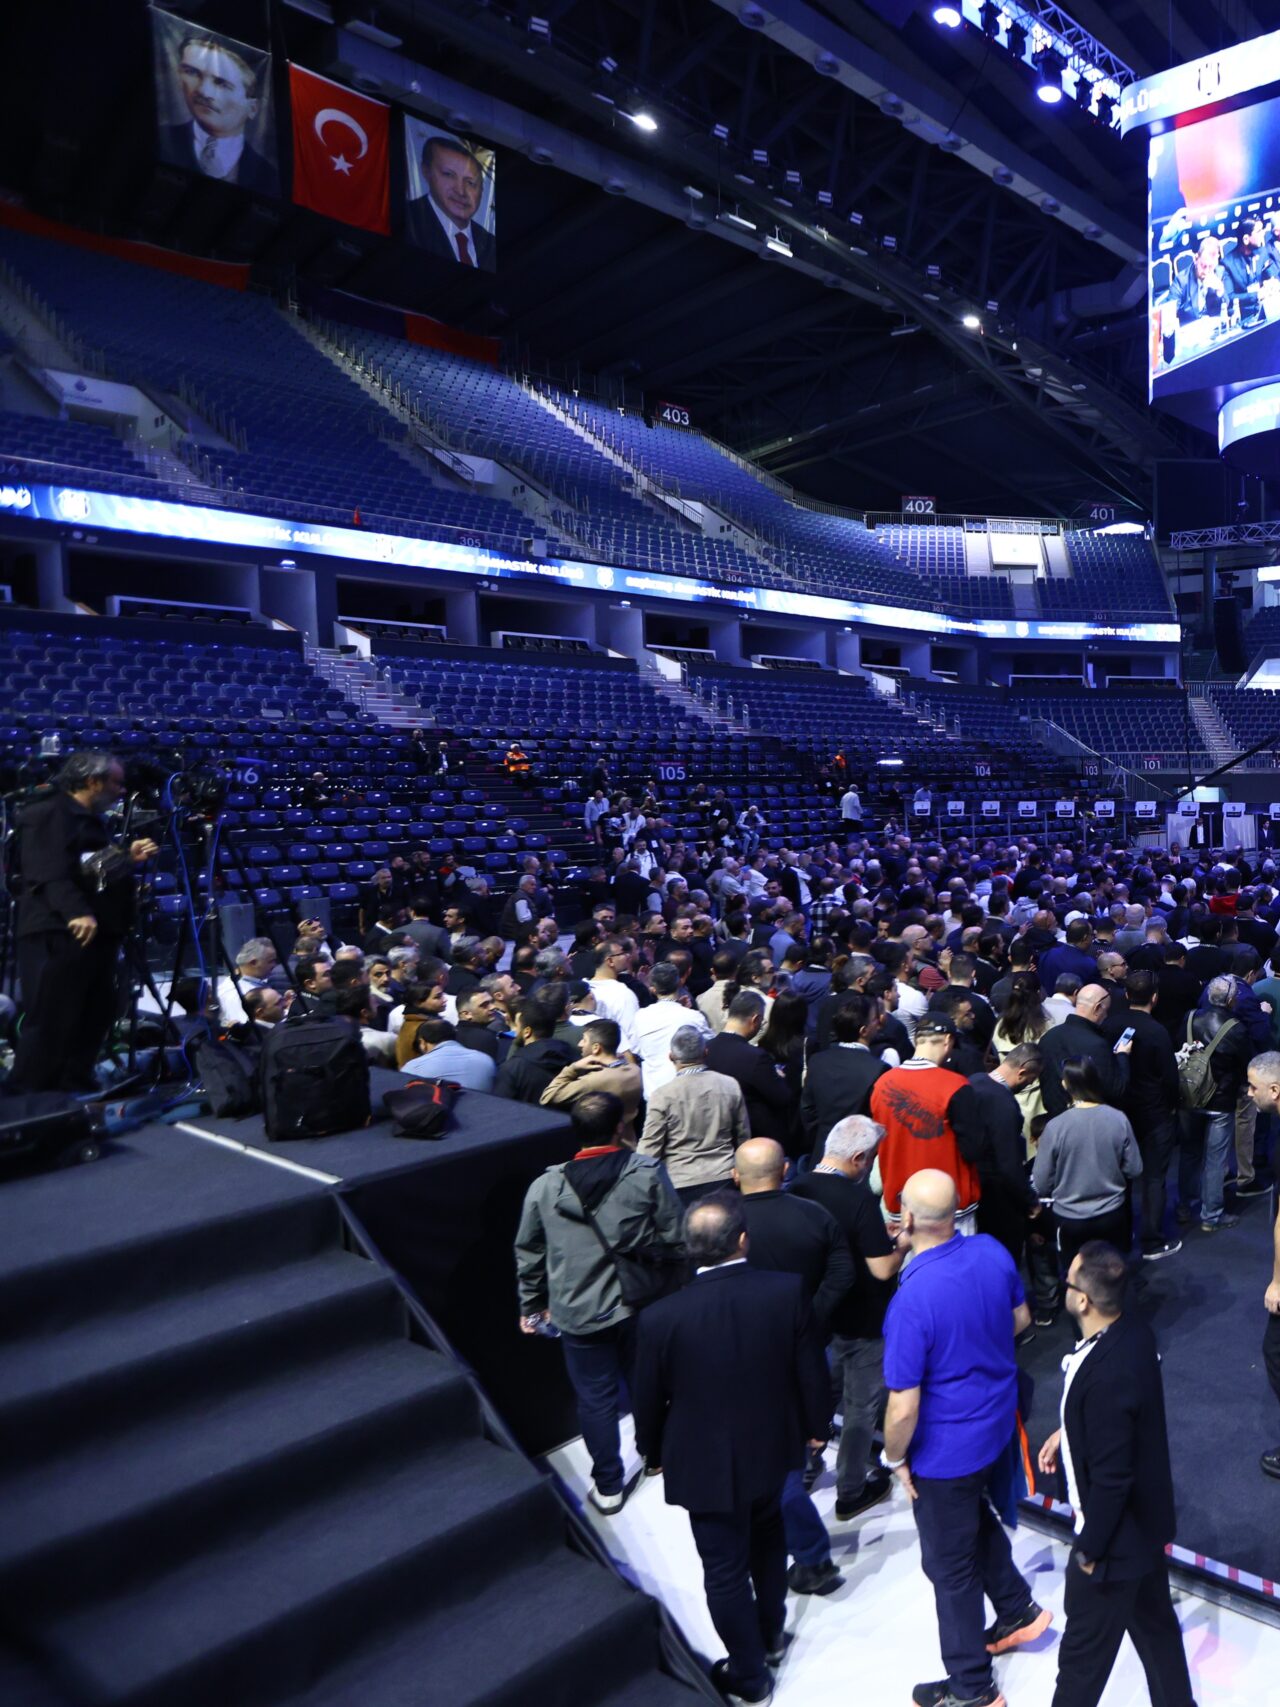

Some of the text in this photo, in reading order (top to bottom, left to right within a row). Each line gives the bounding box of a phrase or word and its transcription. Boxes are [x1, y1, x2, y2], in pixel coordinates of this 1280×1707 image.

[662, 408, 689, 425] 403
[905, 500, 934, 513] 402
[1090, 507, 1115, 520] 401
[460, 536, 481, 548] 305
[726, 575, 742, 583] 304
[974, 765, 991, 777] 104
[1085, 765, 1098, 776] 103
[1144, 760, 1161, 770] 101
[659, 766, 685, 780] 105
